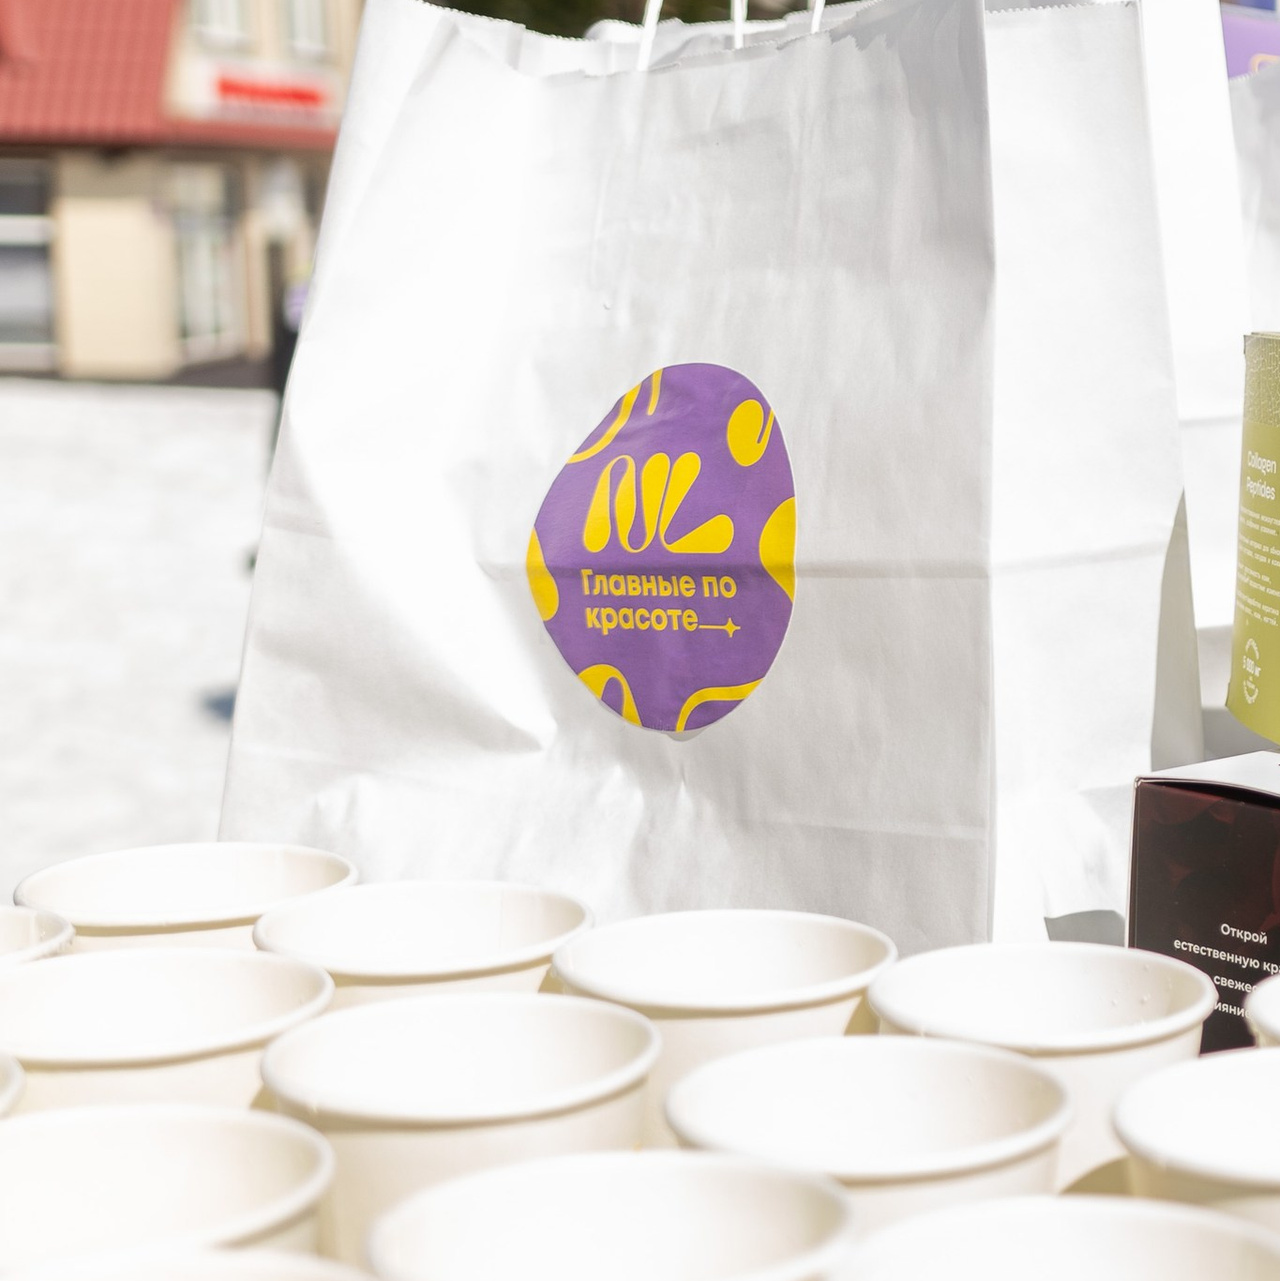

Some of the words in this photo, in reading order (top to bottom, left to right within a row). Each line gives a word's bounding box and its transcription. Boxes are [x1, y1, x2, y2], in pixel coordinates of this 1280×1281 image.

[580, 568, 696, 598] Главные
[703, 574, 737, 599] по
[585, 606, 699, 636] красоте
[1220, 922, 1268, 945] Открой
[1173, 939, 1260, 969] естественную
[1213, 975, 1257, 993] свеже
